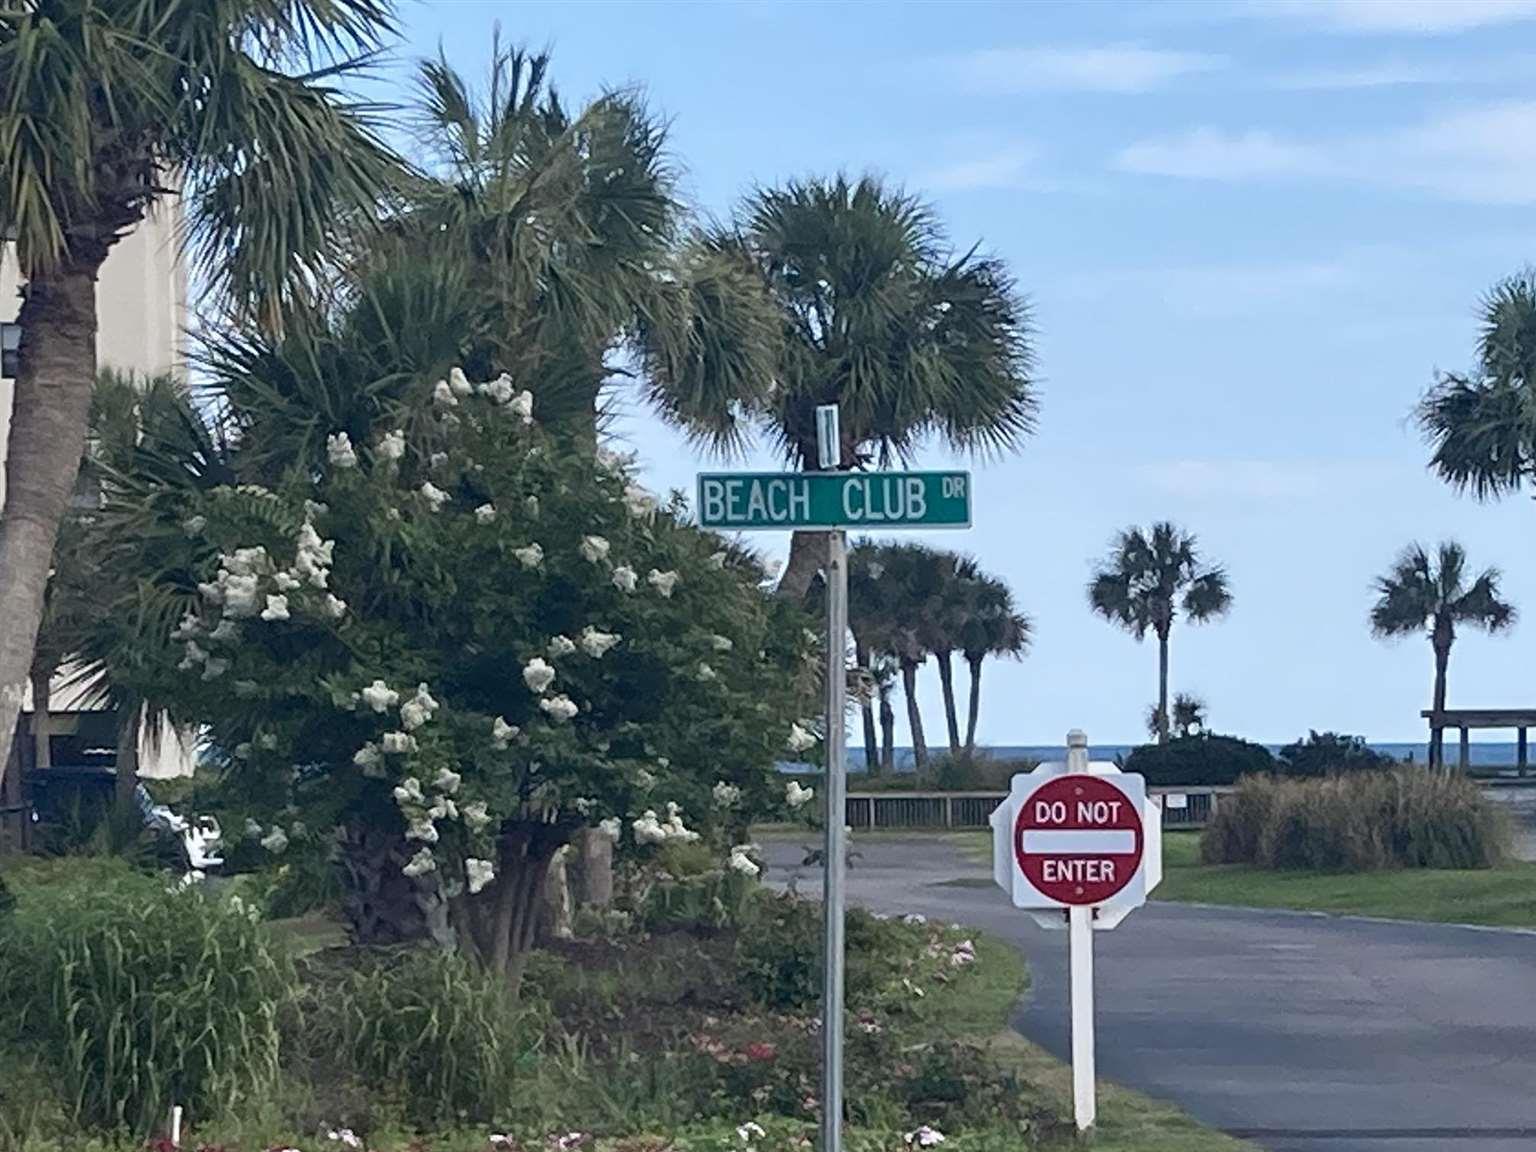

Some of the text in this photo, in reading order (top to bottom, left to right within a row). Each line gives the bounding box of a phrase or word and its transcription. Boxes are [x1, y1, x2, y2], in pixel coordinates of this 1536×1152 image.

[703, 476, 965, 522] BEACH CLUB DR
[1035, 801, 1122, 823] DO NOT
[1042, 859, 1115, 882] ENTER
